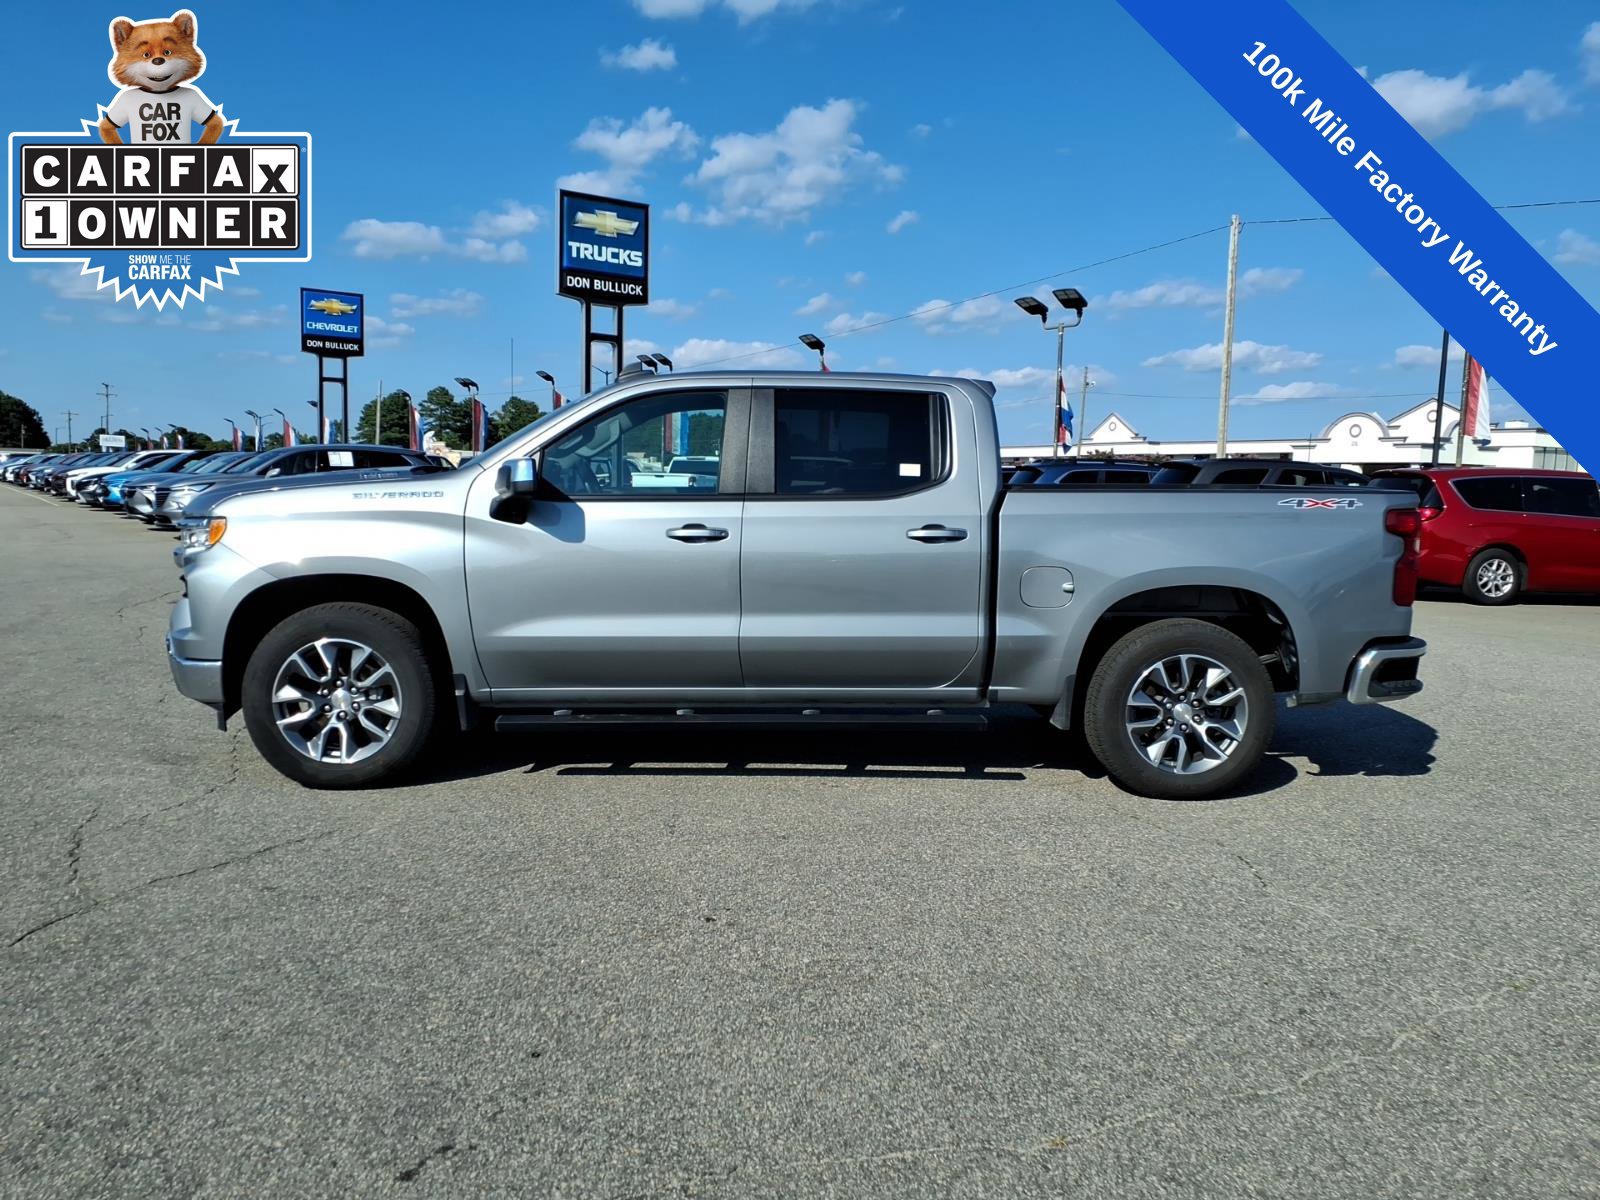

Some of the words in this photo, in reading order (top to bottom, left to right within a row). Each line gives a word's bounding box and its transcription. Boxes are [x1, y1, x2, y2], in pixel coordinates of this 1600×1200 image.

[567, 240, 643, 267] TRUCKS
[566, 275, 590, 289] DON
[593, 279, 643, 296] BULLUCK
[306, 321, 358, 333] CHEVROLET
[306, 339, 323, 348] DON
[325, 341, 360, 352] BULLUCK
